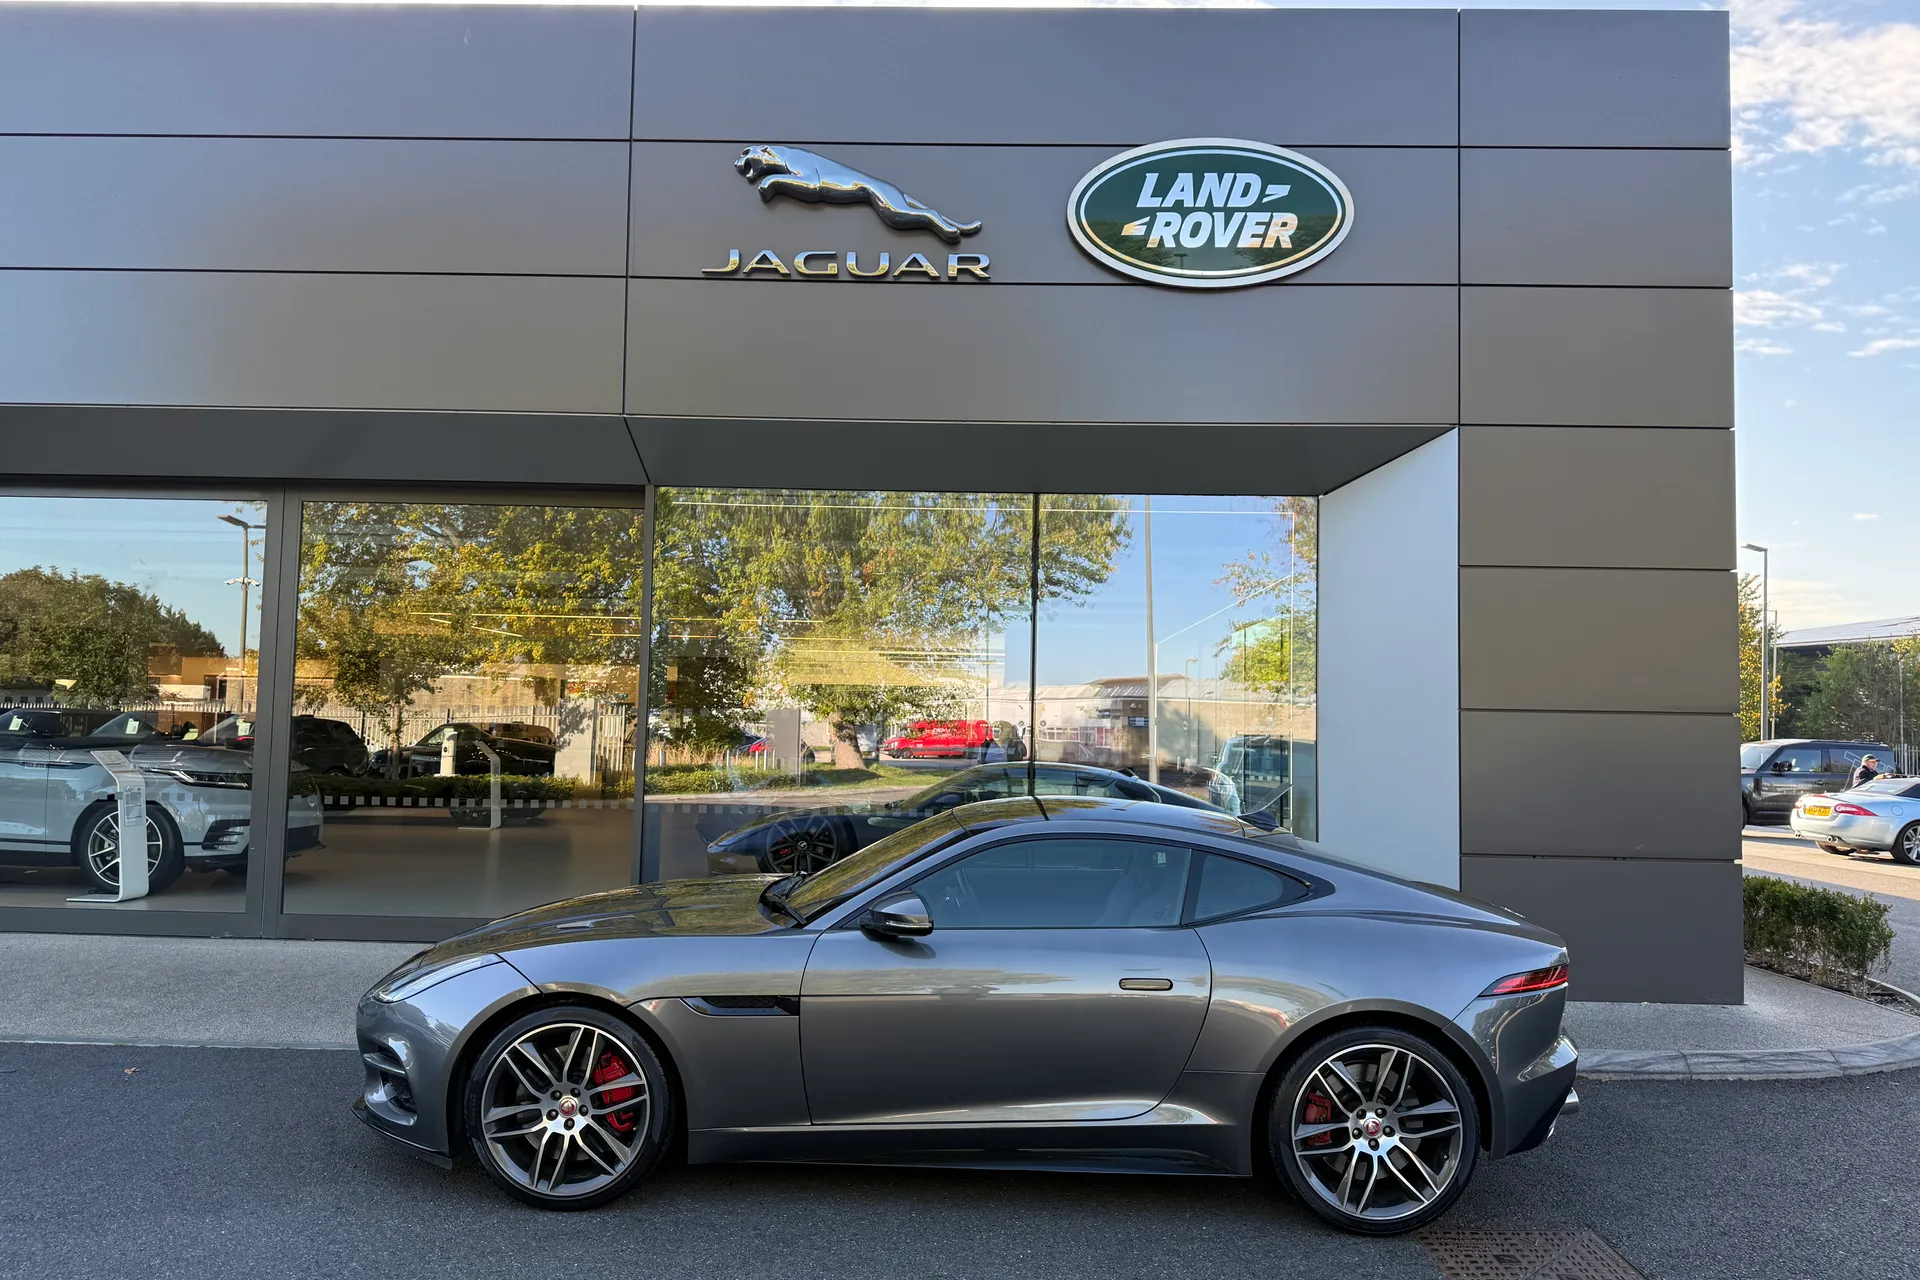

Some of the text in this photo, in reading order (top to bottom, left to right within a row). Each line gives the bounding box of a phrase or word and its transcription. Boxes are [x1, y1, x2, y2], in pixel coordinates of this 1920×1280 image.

[1136, 172, 1262, 208] LAND
[1146, 211, 1299, 249] ROVER
[702, 248, 992, 280] JAGUAR
